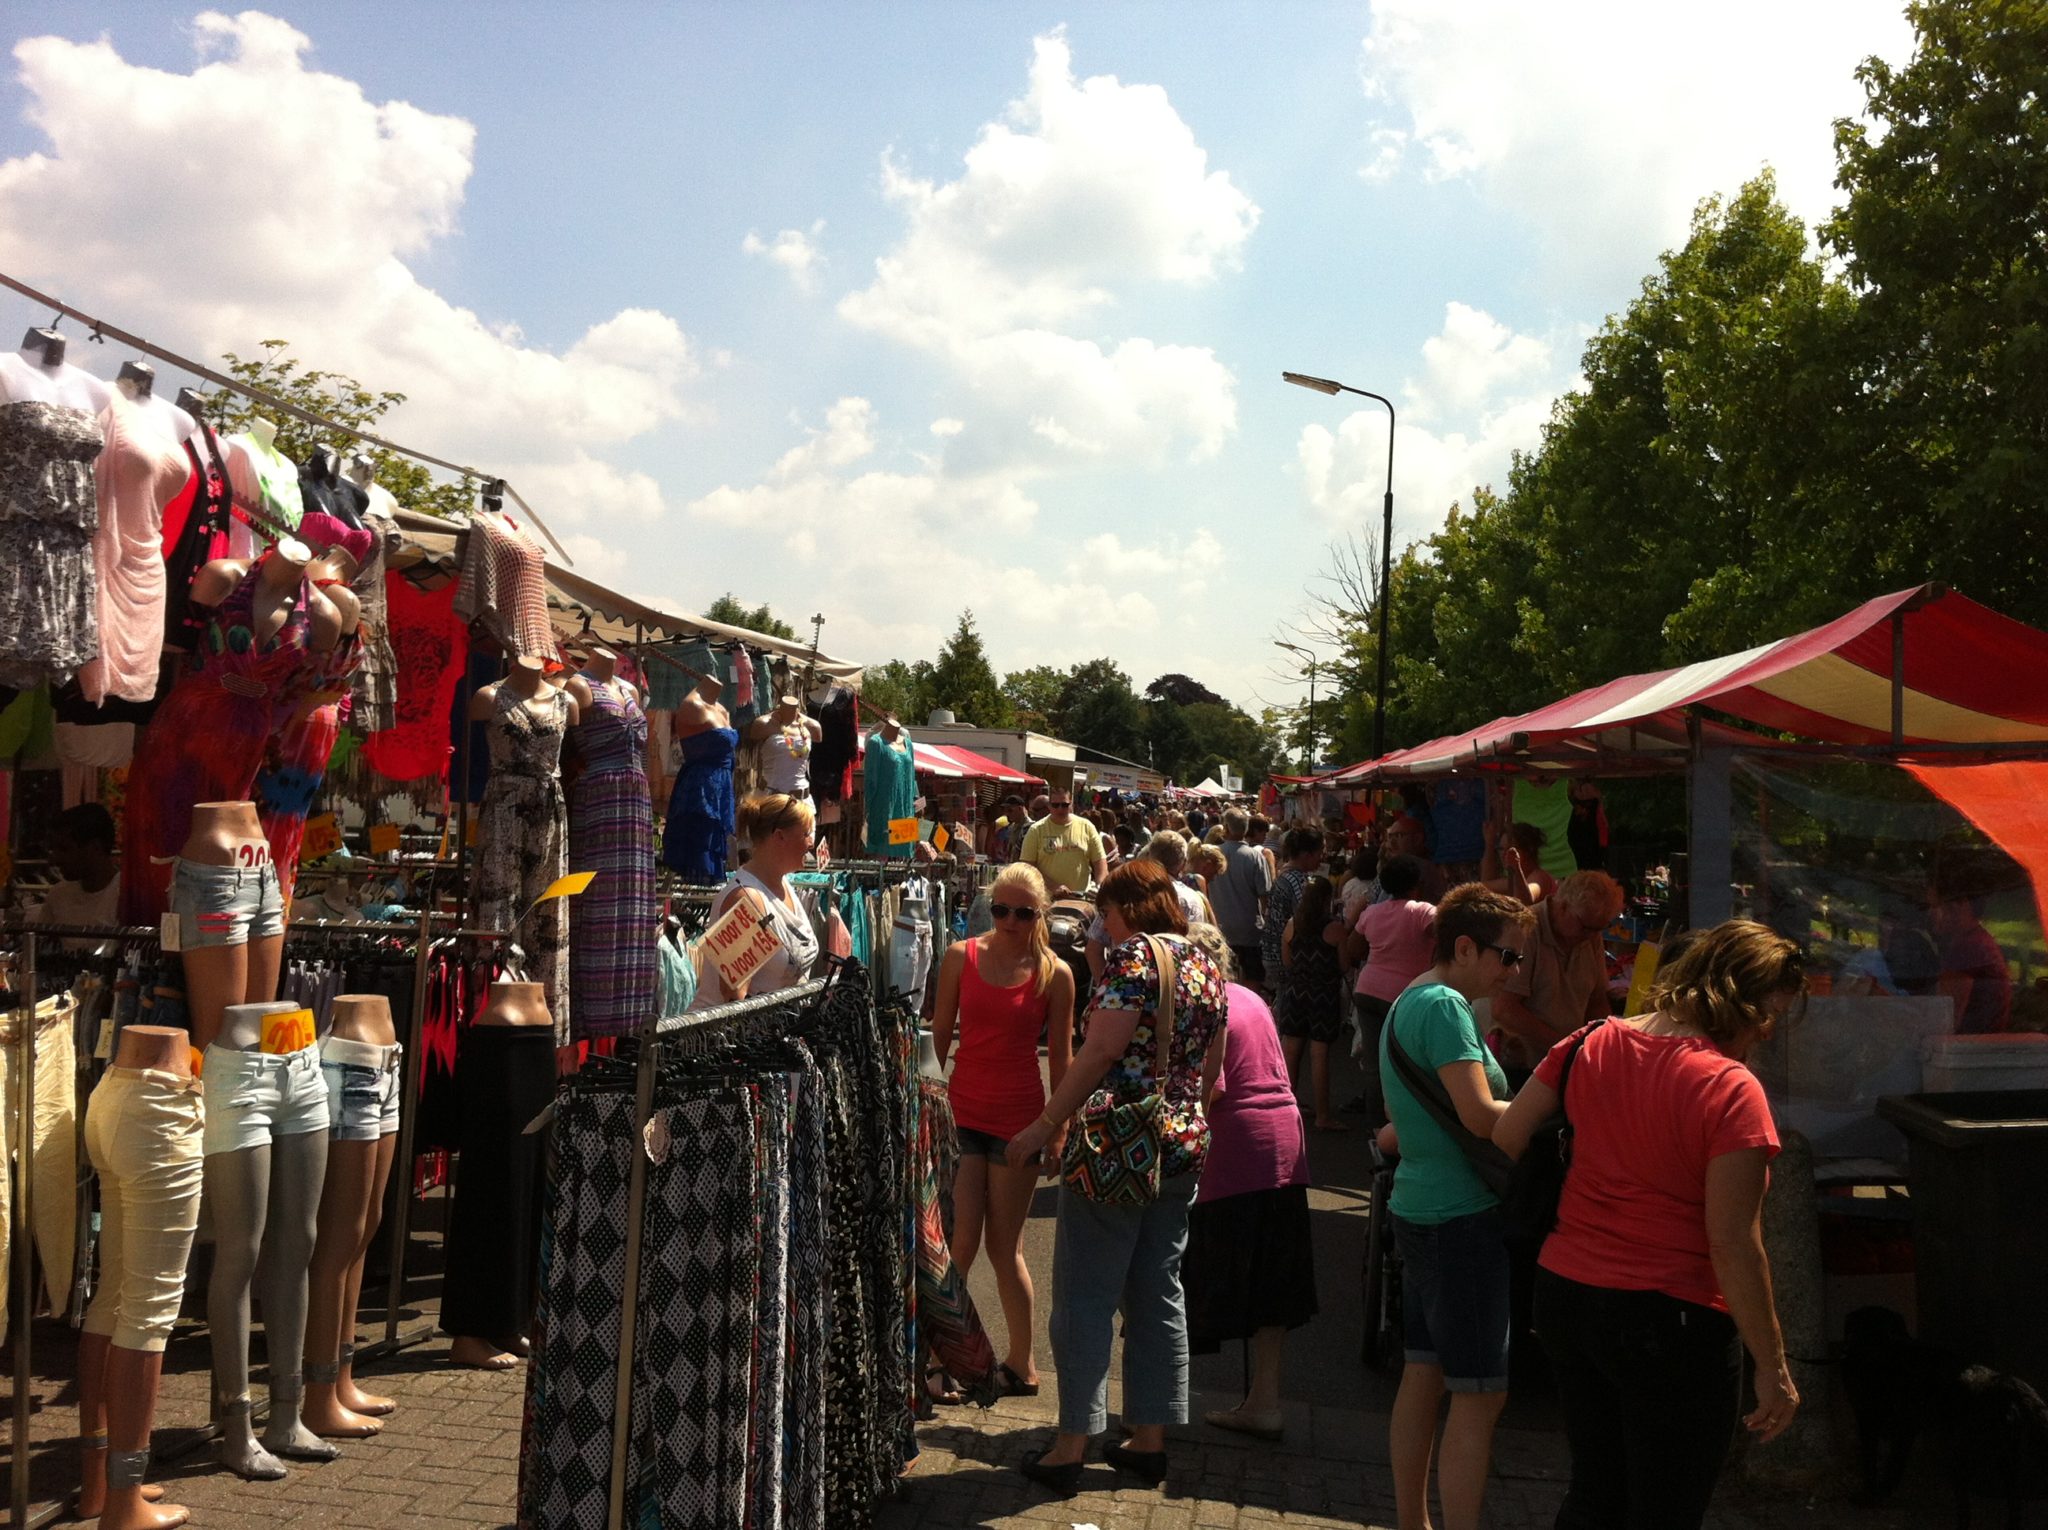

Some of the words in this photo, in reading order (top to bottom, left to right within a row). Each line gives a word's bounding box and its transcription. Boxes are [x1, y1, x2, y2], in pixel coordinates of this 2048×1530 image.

[705, 936, 720, 956] 1
[714, 920, 742, 949] voor
[733, 903, 756, 929] 8€
[720, 963, 738, 984] 2
[730, 947, 758, 976] voor
[752, 928, 778, 956] 15€
